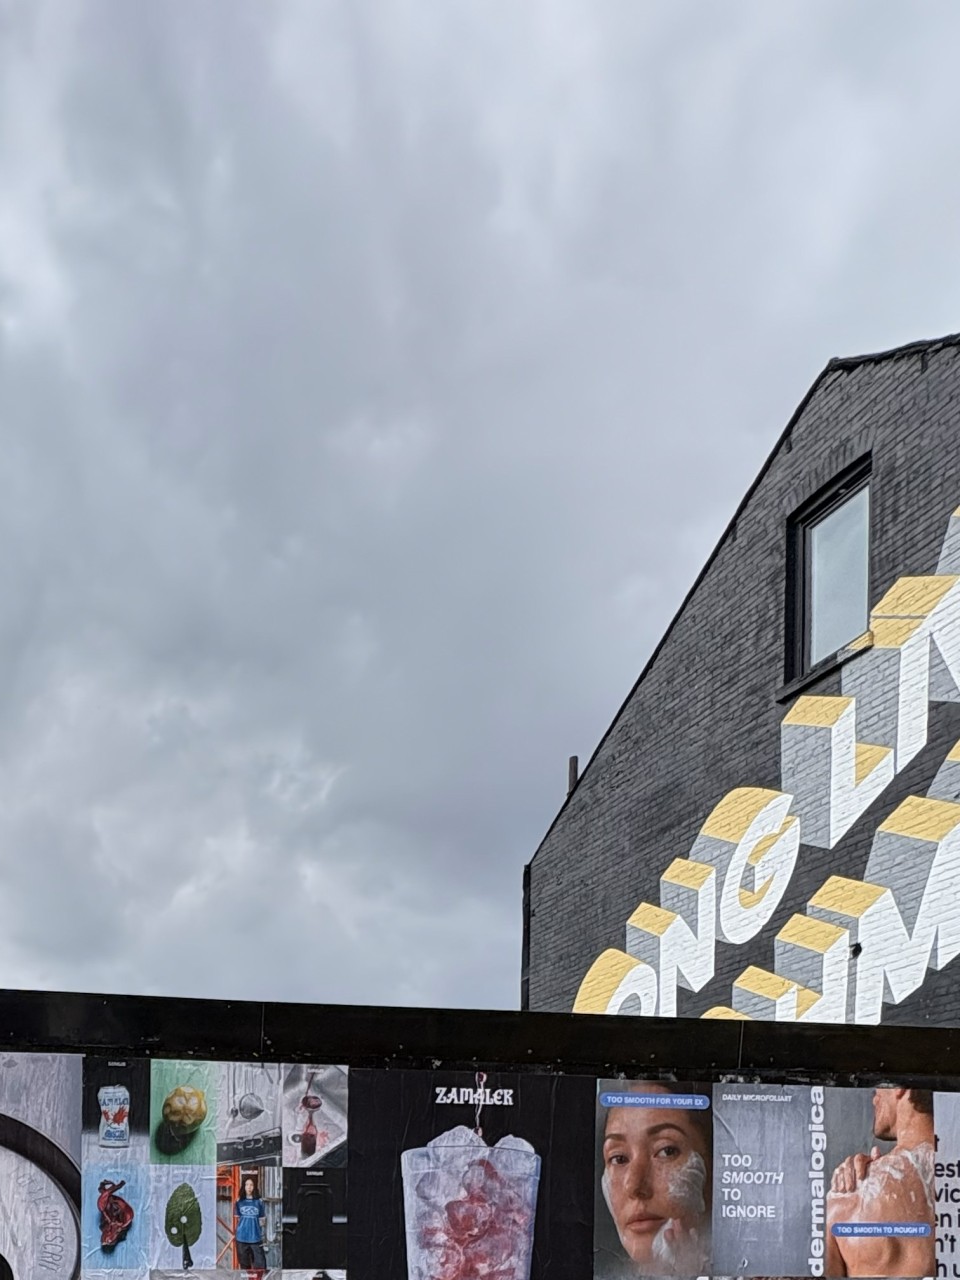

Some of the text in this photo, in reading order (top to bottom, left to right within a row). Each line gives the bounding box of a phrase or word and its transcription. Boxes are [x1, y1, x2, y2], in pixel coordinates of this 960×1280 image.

[435, 1086, 514, 1106] ZAMALEK
[607, 1096, 704, 1106] TOO SMOOTH FOR YOUR EX
[721, 1154, 752, 1167] TOO
[721, 1171, 785, 1184] SMOOTH
[808, 1085, 827, 1278] dermalogica
[721, 1188, 742, 1200] TO
[721, 1204, 776, 1218] IGNORE
[837, 1226, 925, 1234] TOO SMOOTH TO ROUGH IT
